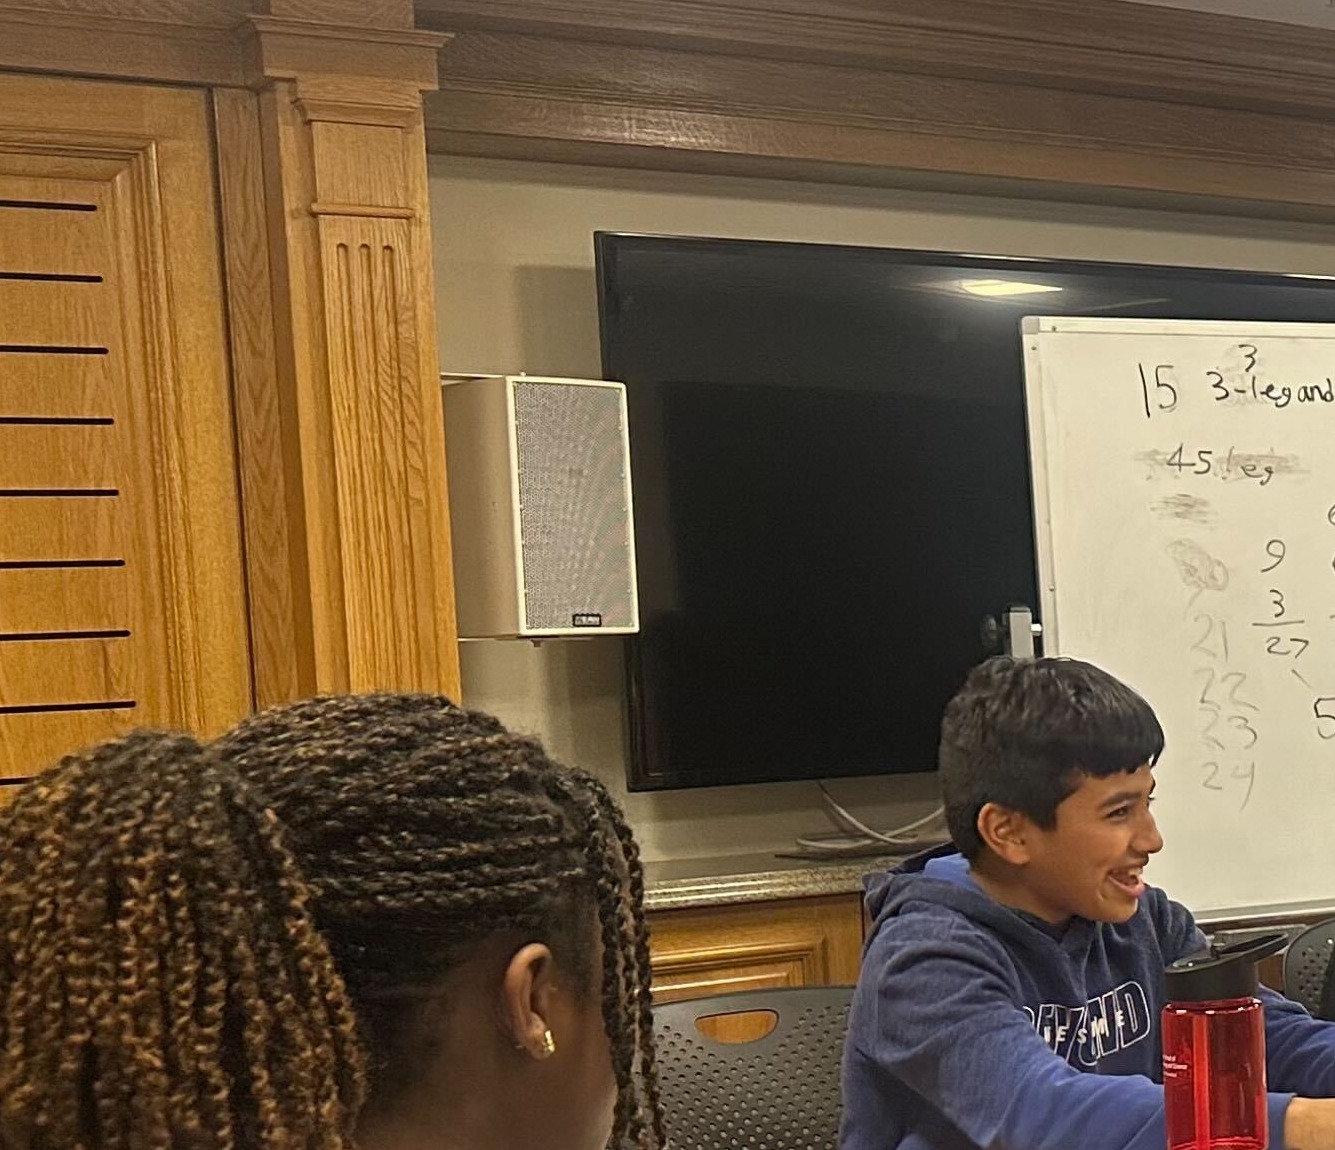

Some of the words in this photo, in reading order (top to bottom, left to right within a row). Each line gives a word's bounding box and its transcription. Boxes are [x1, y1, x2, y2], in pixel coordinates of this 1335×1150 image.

[1138, 362, 1178, 418] 15
[1297, 377, 1335, 402] and
[1166, 442, 1213, 475] 45
[1260, 539, 1287, 573] 9
[1269, 588, 1286, 618] 3
[1265, 636, 1310, 659] 27
